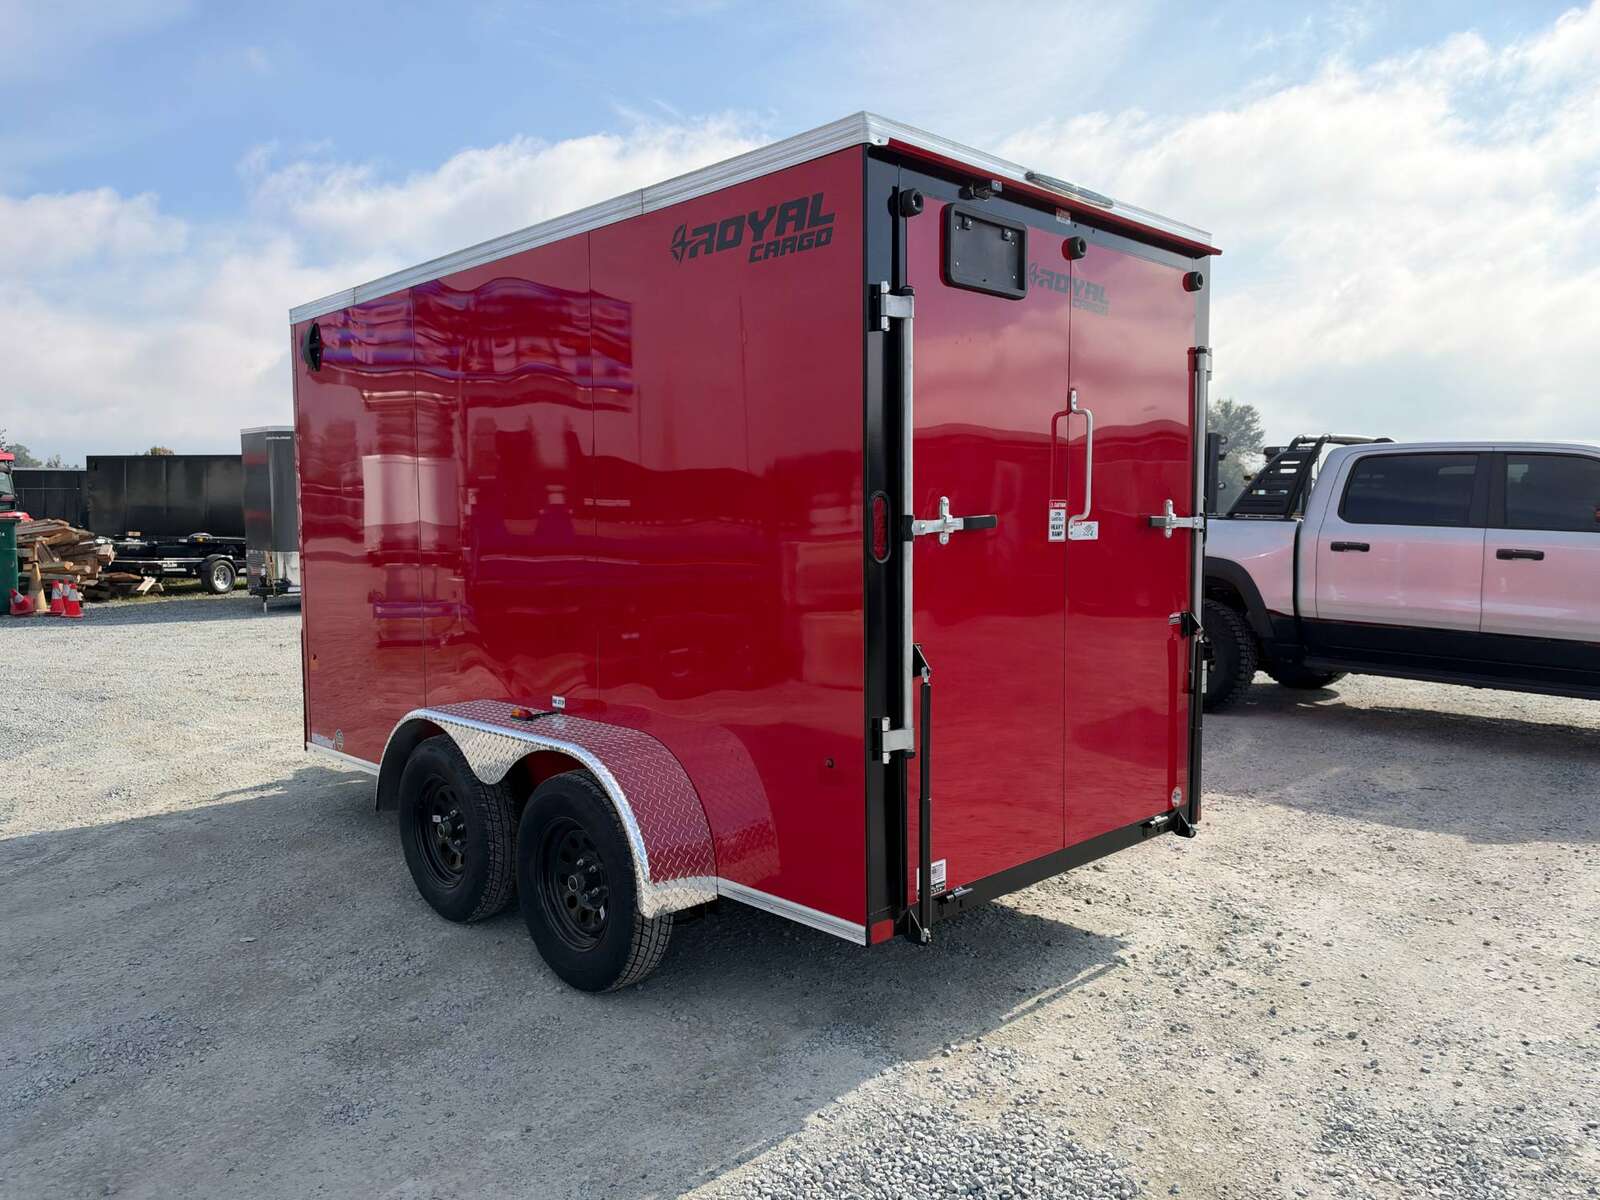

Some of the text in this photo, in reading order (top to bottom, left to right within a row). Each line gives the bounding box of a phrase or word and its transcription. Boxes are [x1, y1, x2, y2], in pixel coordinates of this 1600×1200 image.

[688, 192, 836, 259] ROYAL
[748, 227, 834, 263] CARGO
[1039, 268, 1110, 304] ROYAL
